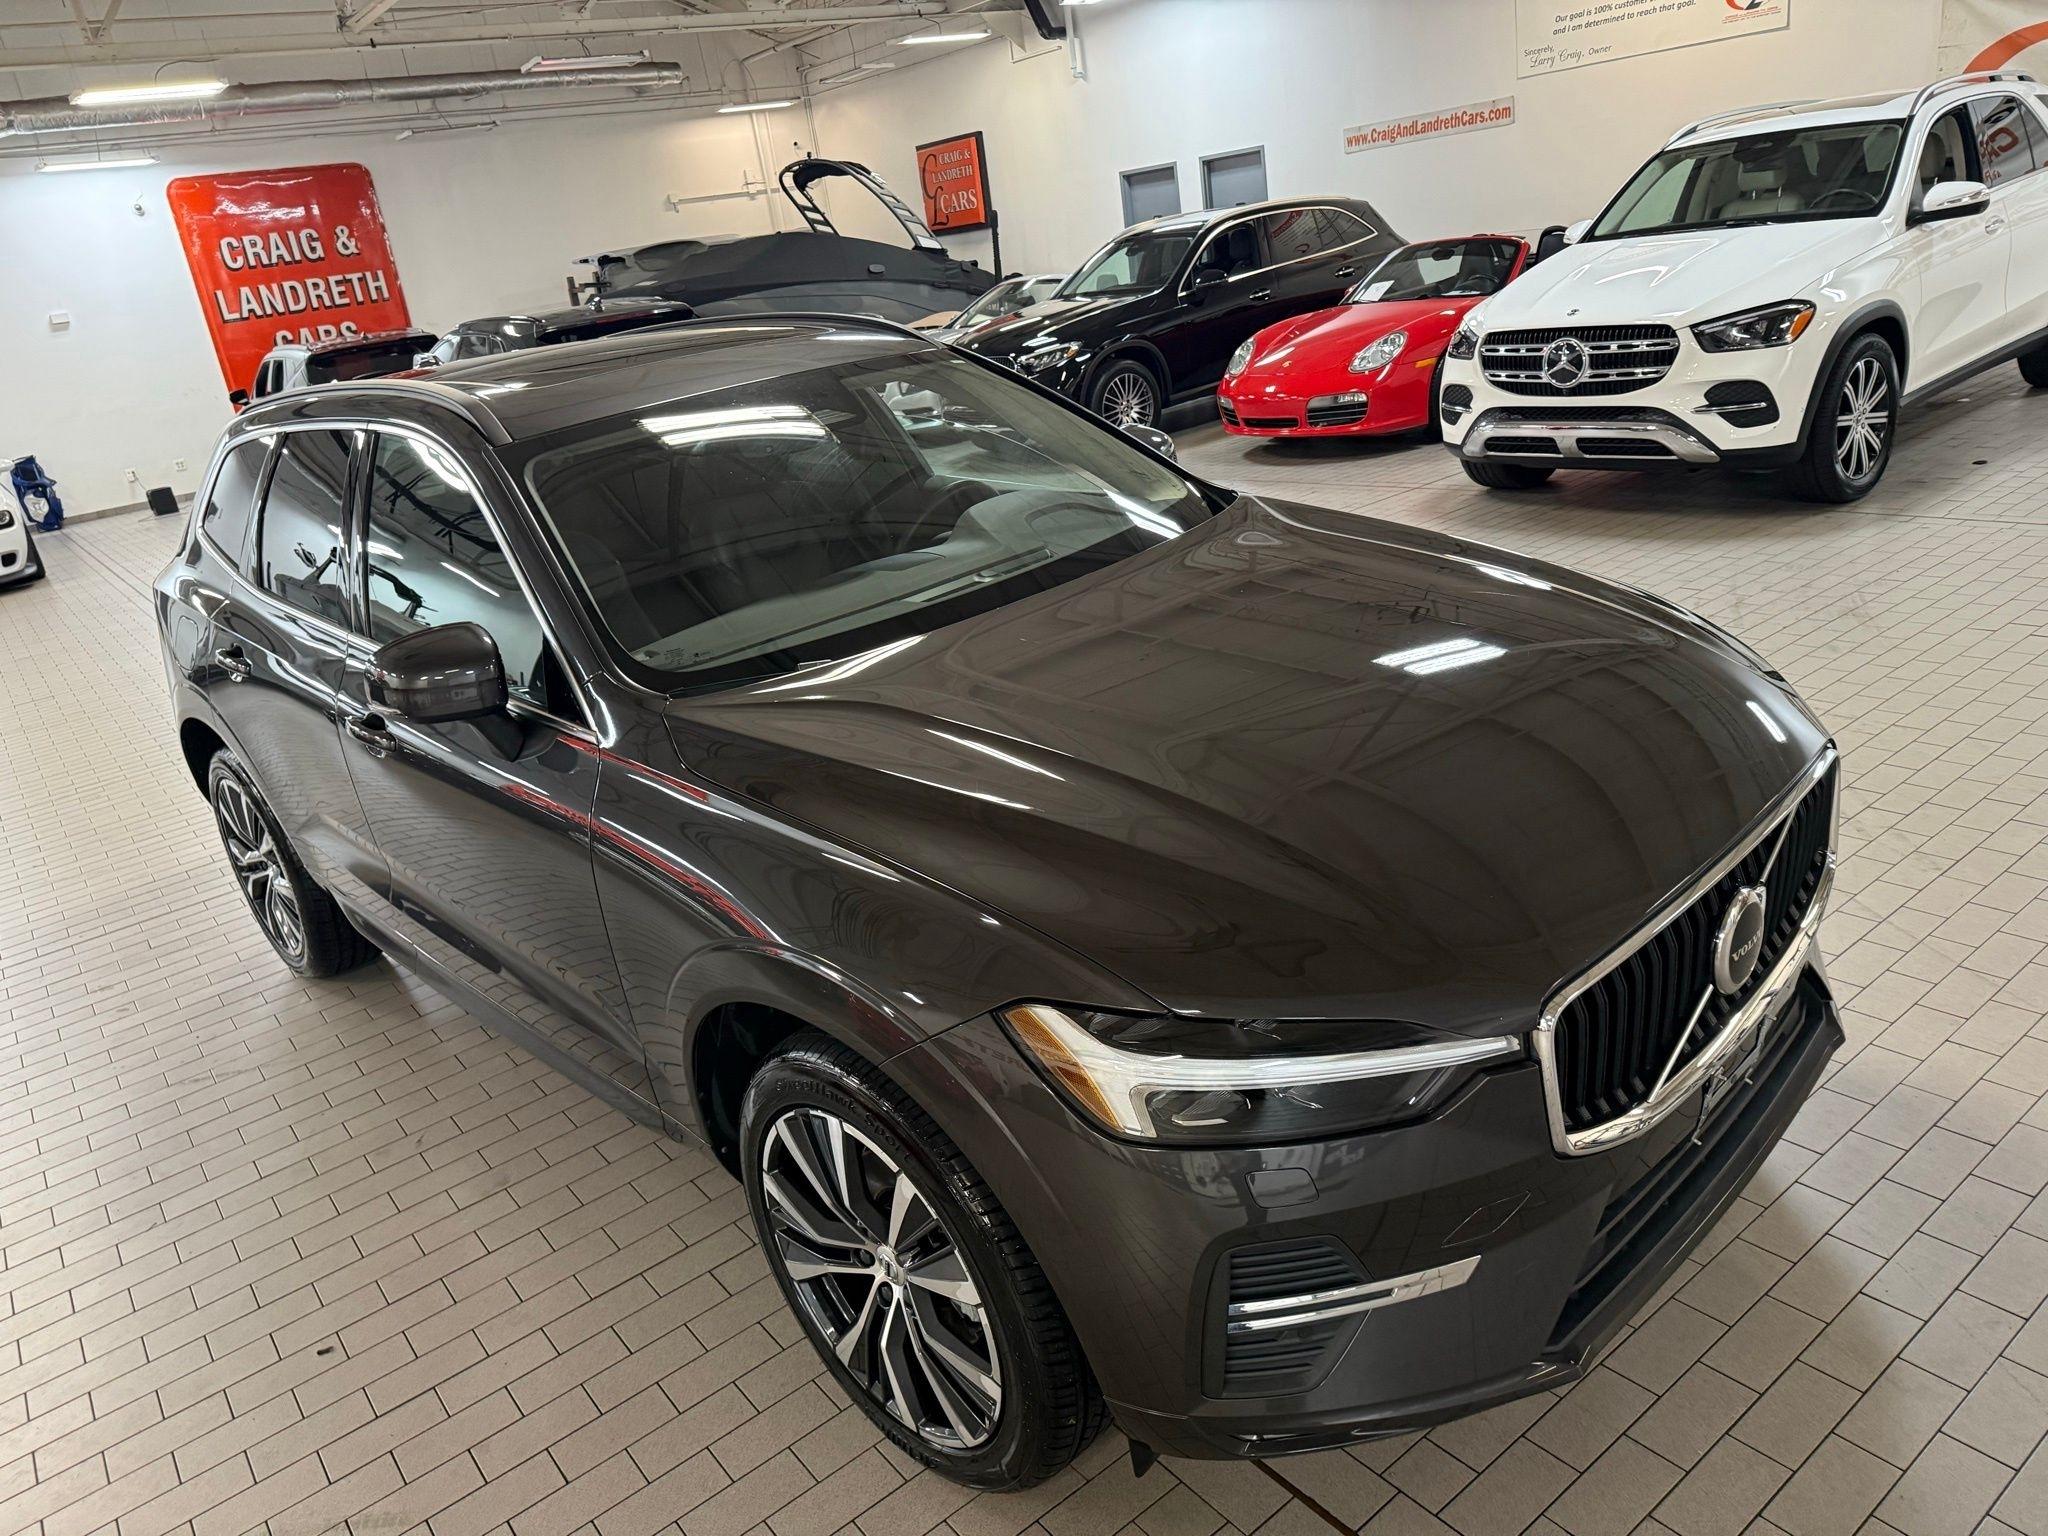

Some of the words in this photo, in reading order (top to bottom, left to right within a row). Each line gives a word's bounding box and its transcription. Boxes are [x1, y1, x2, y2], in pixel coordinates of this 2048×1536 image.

[1552, 25, 1567, 36] and
[1571, 24, 1583, 32] am
[1584, 12, 1626, 29] determined
[1627, 12, 1635, 20] to
[1636, 7, 1657, 18] reach
[1658, 3, 1676, 13] that
[1555, 15, 1569, 24] Our
[1569, 11, 1585, 22] goal
[1586, 7, 1593, 17] is
[1594, 3, 1613, 15] 100%
[1523, 44, 1555, 58] Sincerely,
[1530, 54, 1556, 68] Larry
[1588, 44, 1613, 57] Owner
[1346, 105, 1512, 148] www.CraigAndLandrethCars.com
[939, 149, 963, 165] CRAIG
[964, 149, 971, 160] &
[932, 165, 973, 183] LANDRETH
[940, 188, 978, 214] CARS
[219, 227, 325, 271] CRAIG
[334, 225, 360, 258] &
[215, 269, 391, 324] LANDRETH
